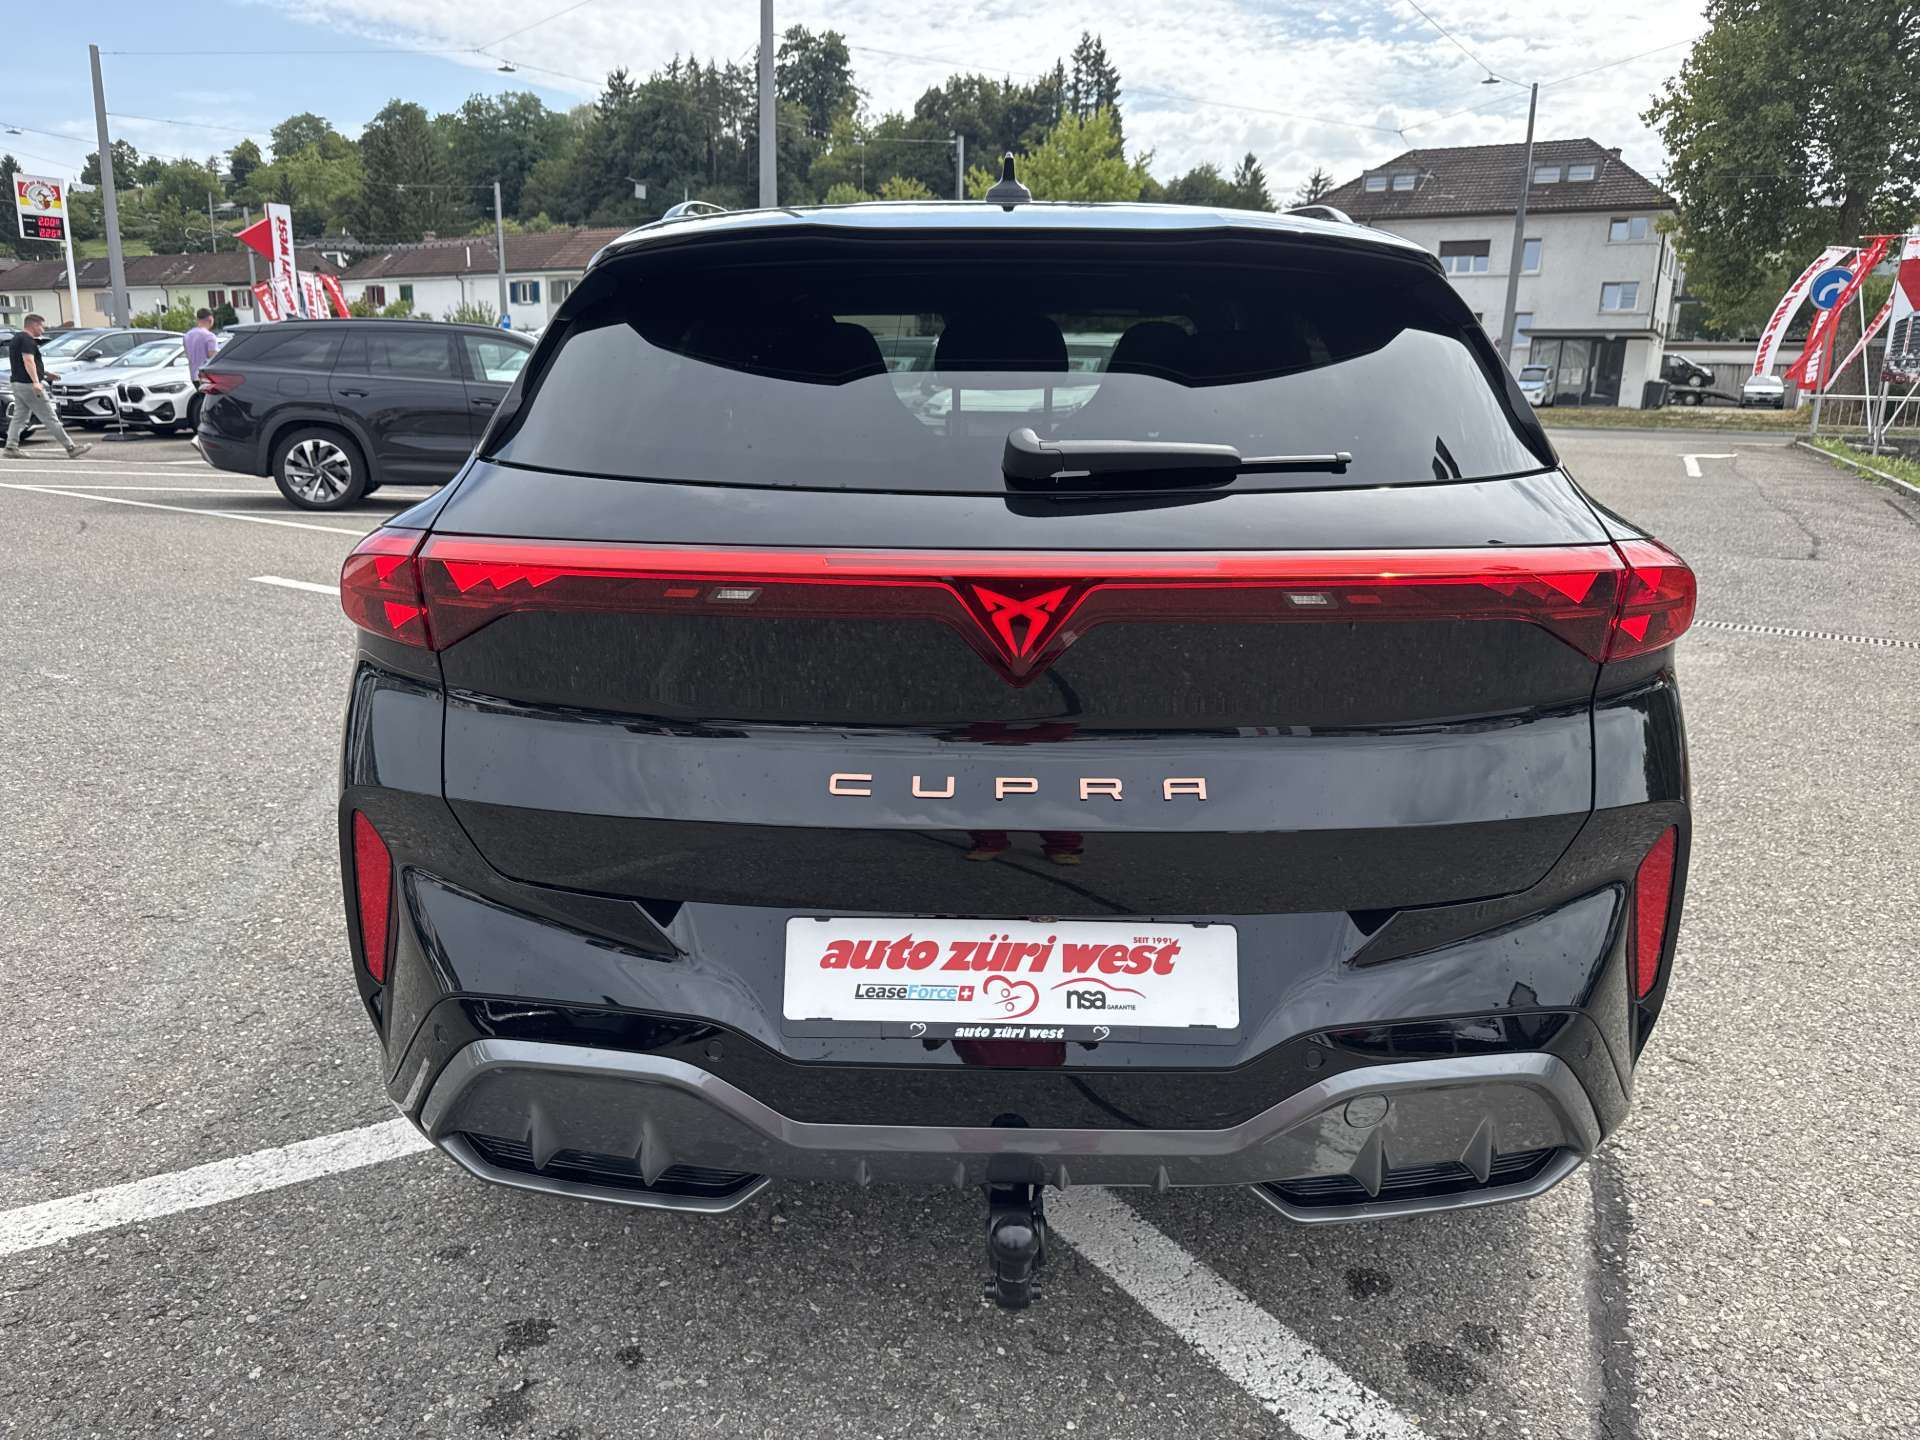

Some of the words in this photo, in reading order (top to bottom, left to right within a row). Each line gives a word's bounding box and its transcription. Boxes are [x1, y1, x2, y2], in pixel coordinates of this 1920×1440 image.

[276, 216, 289, 256] west
[829, 773, 1208, 801] CUPRA
[1133, 936, 1149, 944] SEIT
[1152, 937, 1173, 945] 1991
[819, 933, 940, 971] auto
[940, 934, 1057, 973] züri
[1062, 938, 1182, 976] west
[855, 983, 958, 999] LeaseForce
[1066, 990, 1106, 1010] nsa
[955, 1027, 990, 1038] auto
[992, 1026, 1025, 1039] züri
[1029, 1027, 1064, 1039] west
